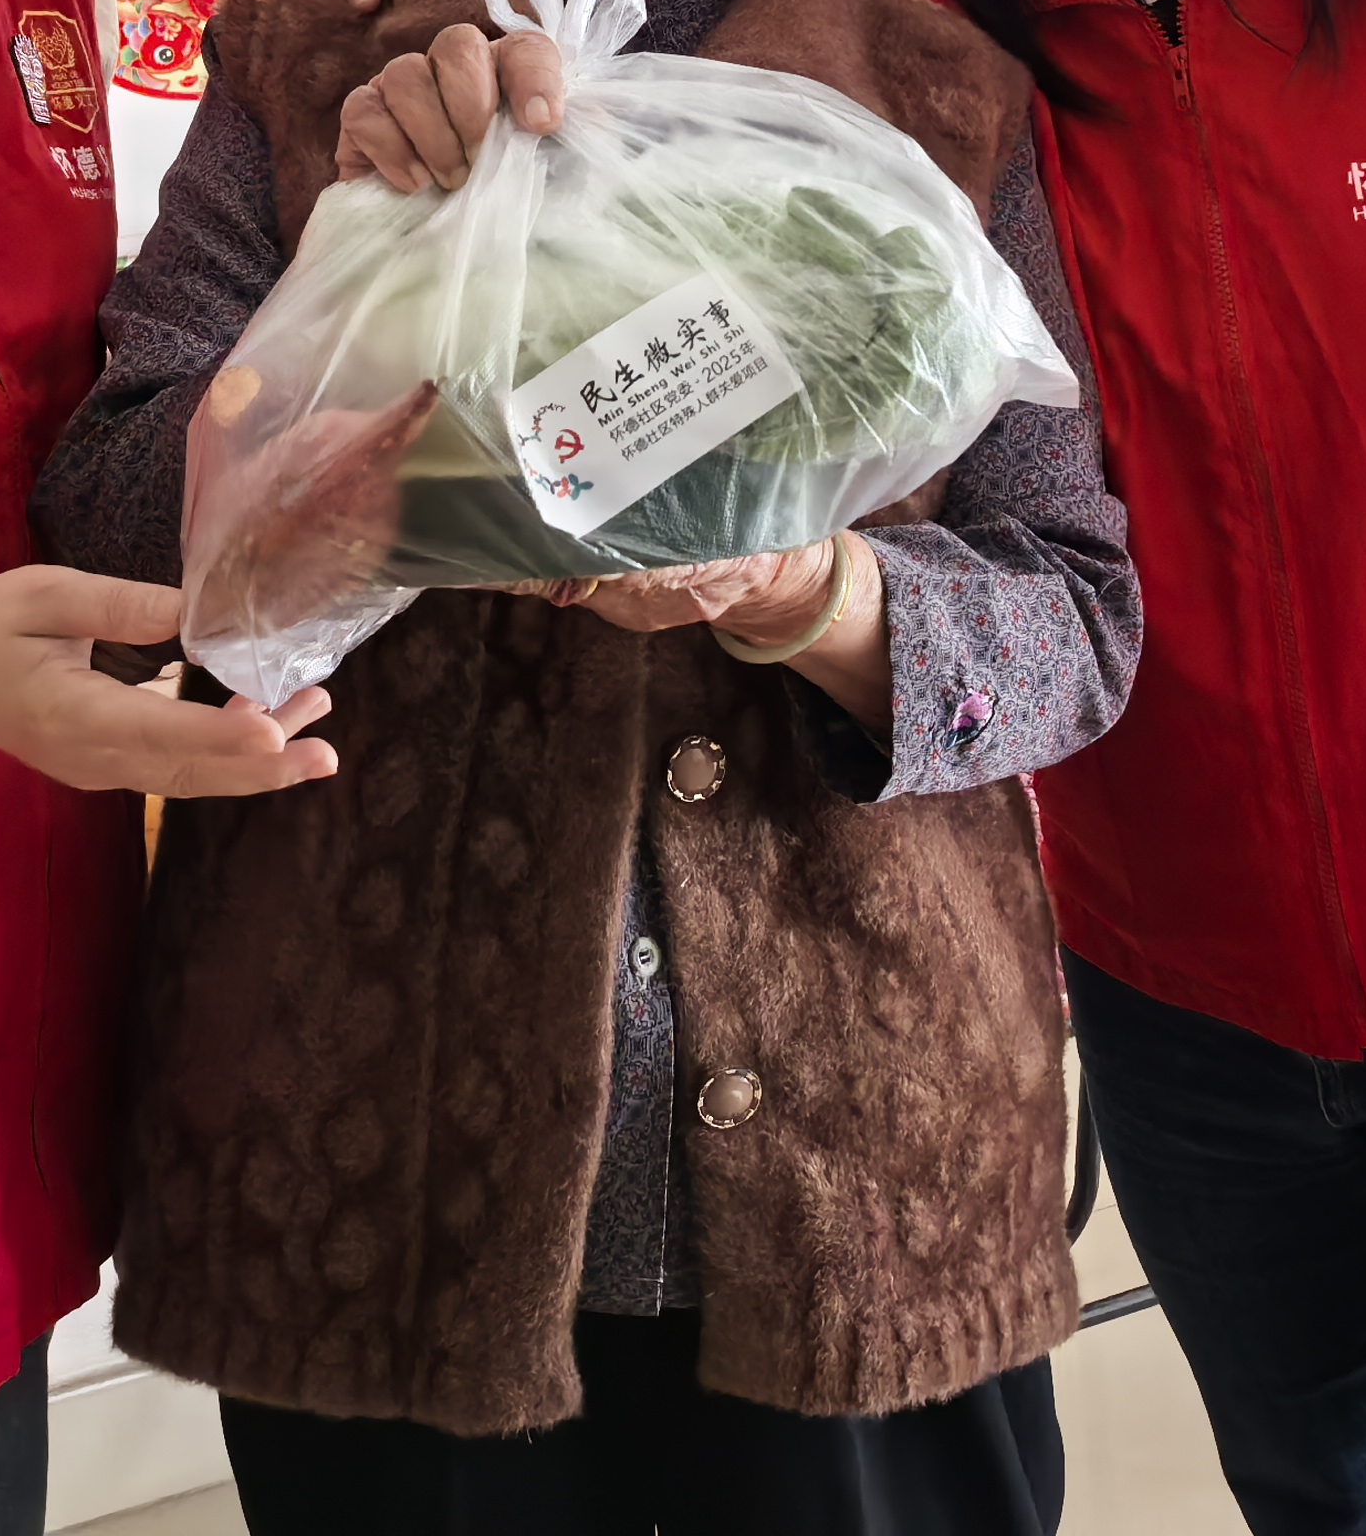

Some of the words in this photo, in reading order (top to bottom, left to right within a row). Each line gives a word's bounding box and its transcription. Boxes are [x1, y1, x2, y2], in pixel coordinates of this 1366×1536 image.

[579, 298, 732, 414] 民生微实事
[597, 407, 625, 428] Min
[627, 377, 670, 408] Sheng
[670, 356, 697, 378] Wei
[700, 340, 722, 360] Shi
[724, 324, 746, 344] Shi
[620, 356, 769, 462] 怀德社区特殊人群关爱项目
